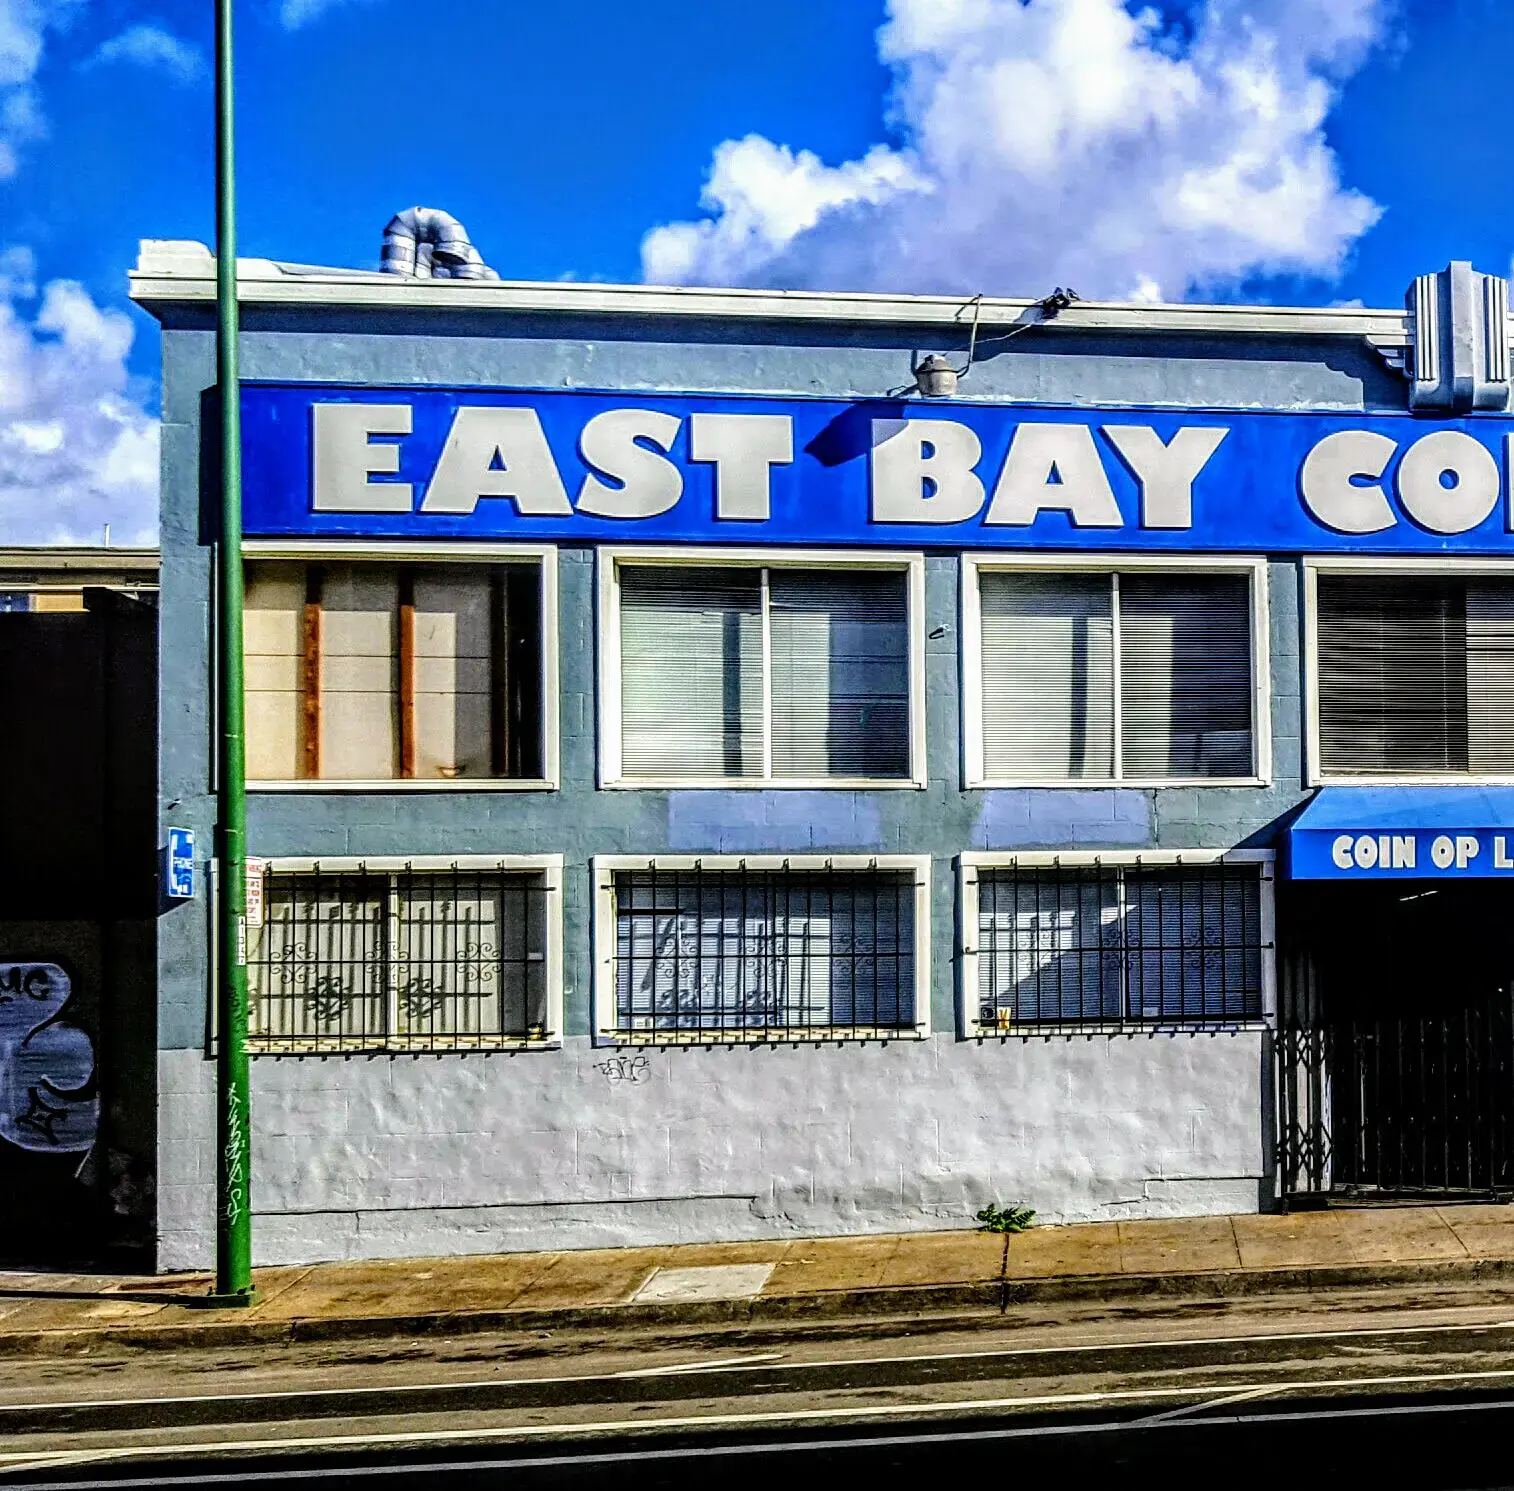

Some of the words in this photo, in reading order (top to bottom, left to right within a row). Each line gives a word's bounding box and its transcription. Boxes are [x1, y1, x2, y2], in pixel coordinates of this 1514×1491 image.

[312, 402, 794, 521] EAST
[871, 418, 1230, 530] BAY
[1331, 834, 1416, 869] COIN
[1430, 835, 1480, 869] OP
